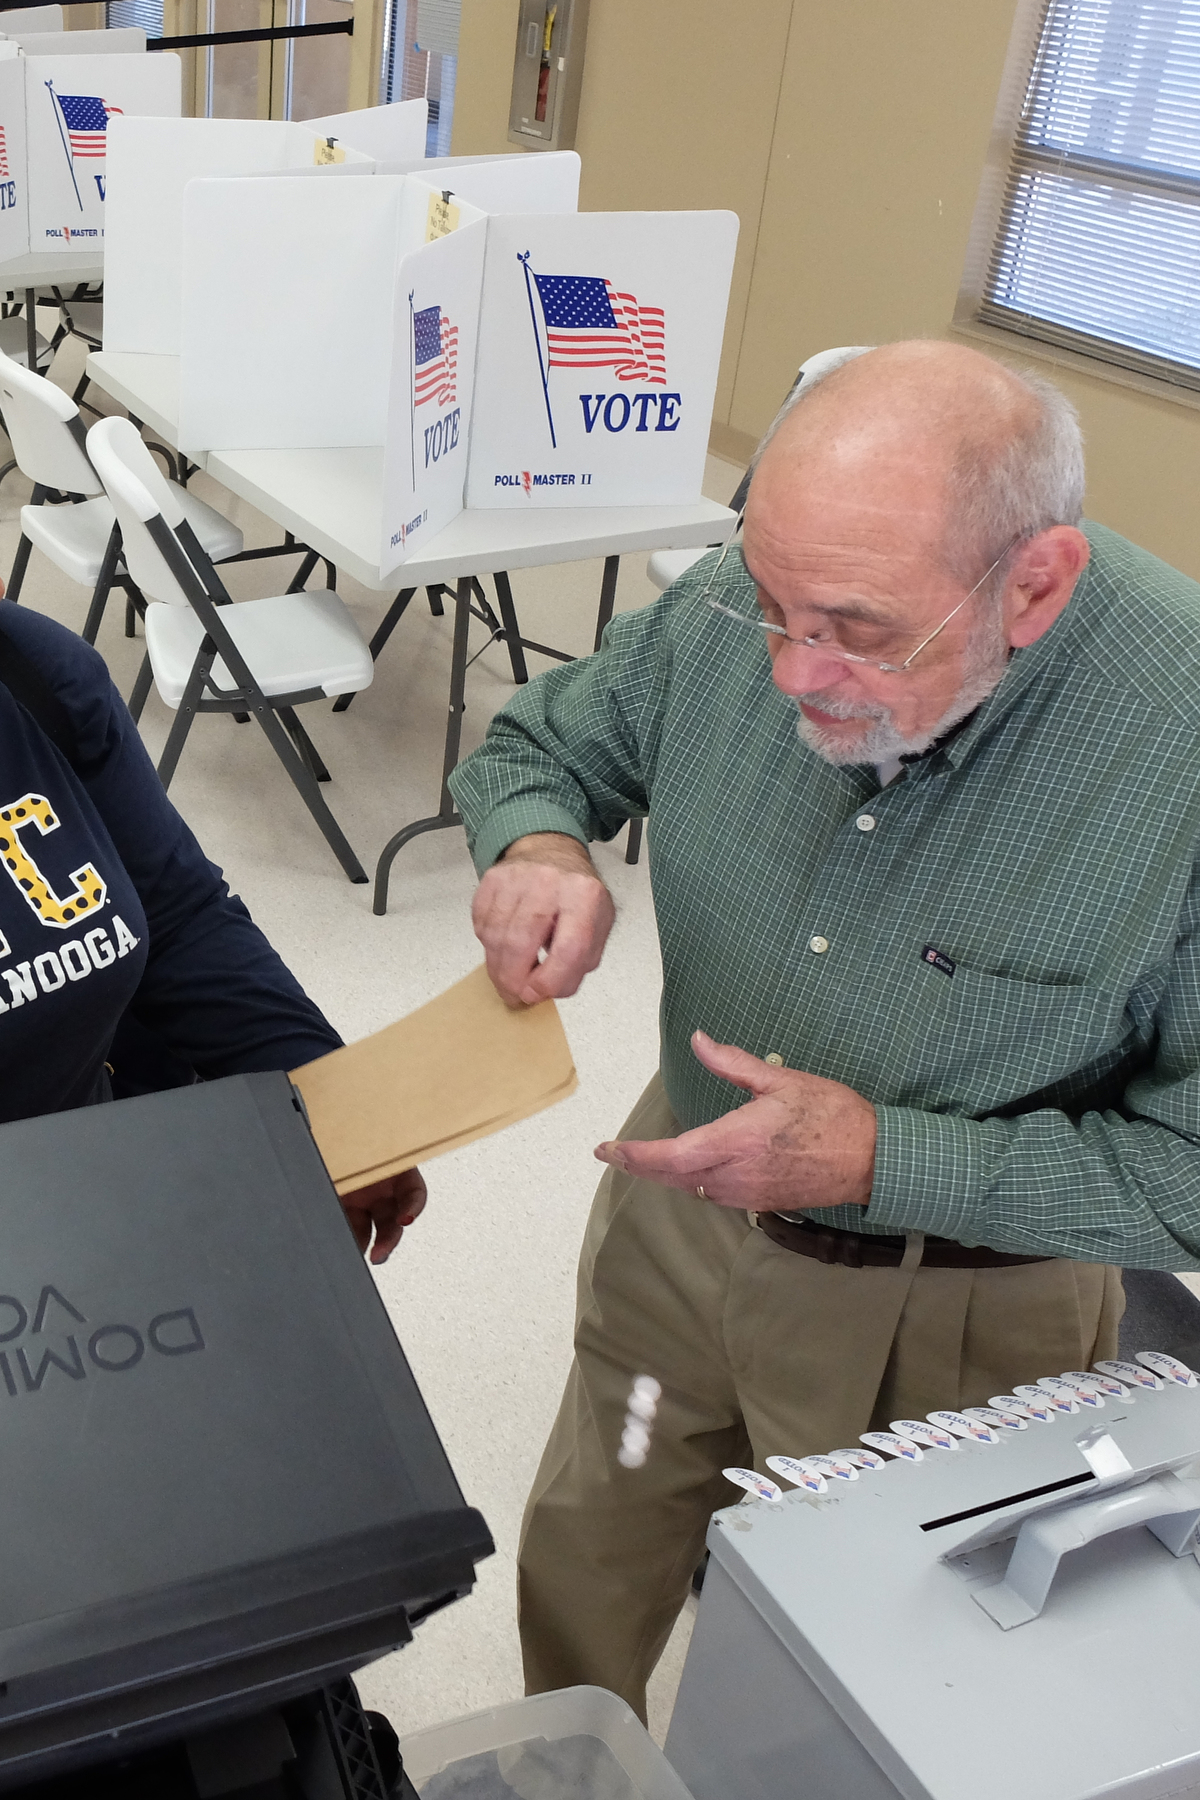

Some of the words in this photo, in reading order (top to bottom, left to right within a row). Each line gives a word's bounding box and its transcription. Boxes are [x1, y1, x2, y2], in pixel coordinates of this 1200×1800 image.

[45, 229, 63, 237] POLL
[70, 229, 98, 237] MASTER
[579, 393, 682, 433] VOTE
[424, 407, 460, 469] VOTE
[494, 475, 521, 486] POLL
[532, 474, 575, 486] MASTER
[580, 474, 592, 485] II
[390, 530, 401, 549] POLL
[405, 514, 422, 536] MASTER
[1148, 1352, 1176, 1369] VOTED
[1104, 1361, 1137, 1374] VOTED
[1071, 1372, 1104, 1383] VOTED
[1048, 1378, 1080, 1391] VOTED
[1024, 1386, 1055, 1398] VOTED
[999, 1396, 1030, 1408] VOTED
[973, 1407, 1003, 1418] VOTED
[937, 1412, 972, 1427] VOTED
[901, 1421, 933, 1435] VOTED
[871, 1433, 900, 1445] VOTED
[778, 1457, 807, 1474] VOTED
[808, 1456, 837, 1467] VOTED
[735, 1469, 762, 1483] VOTED
